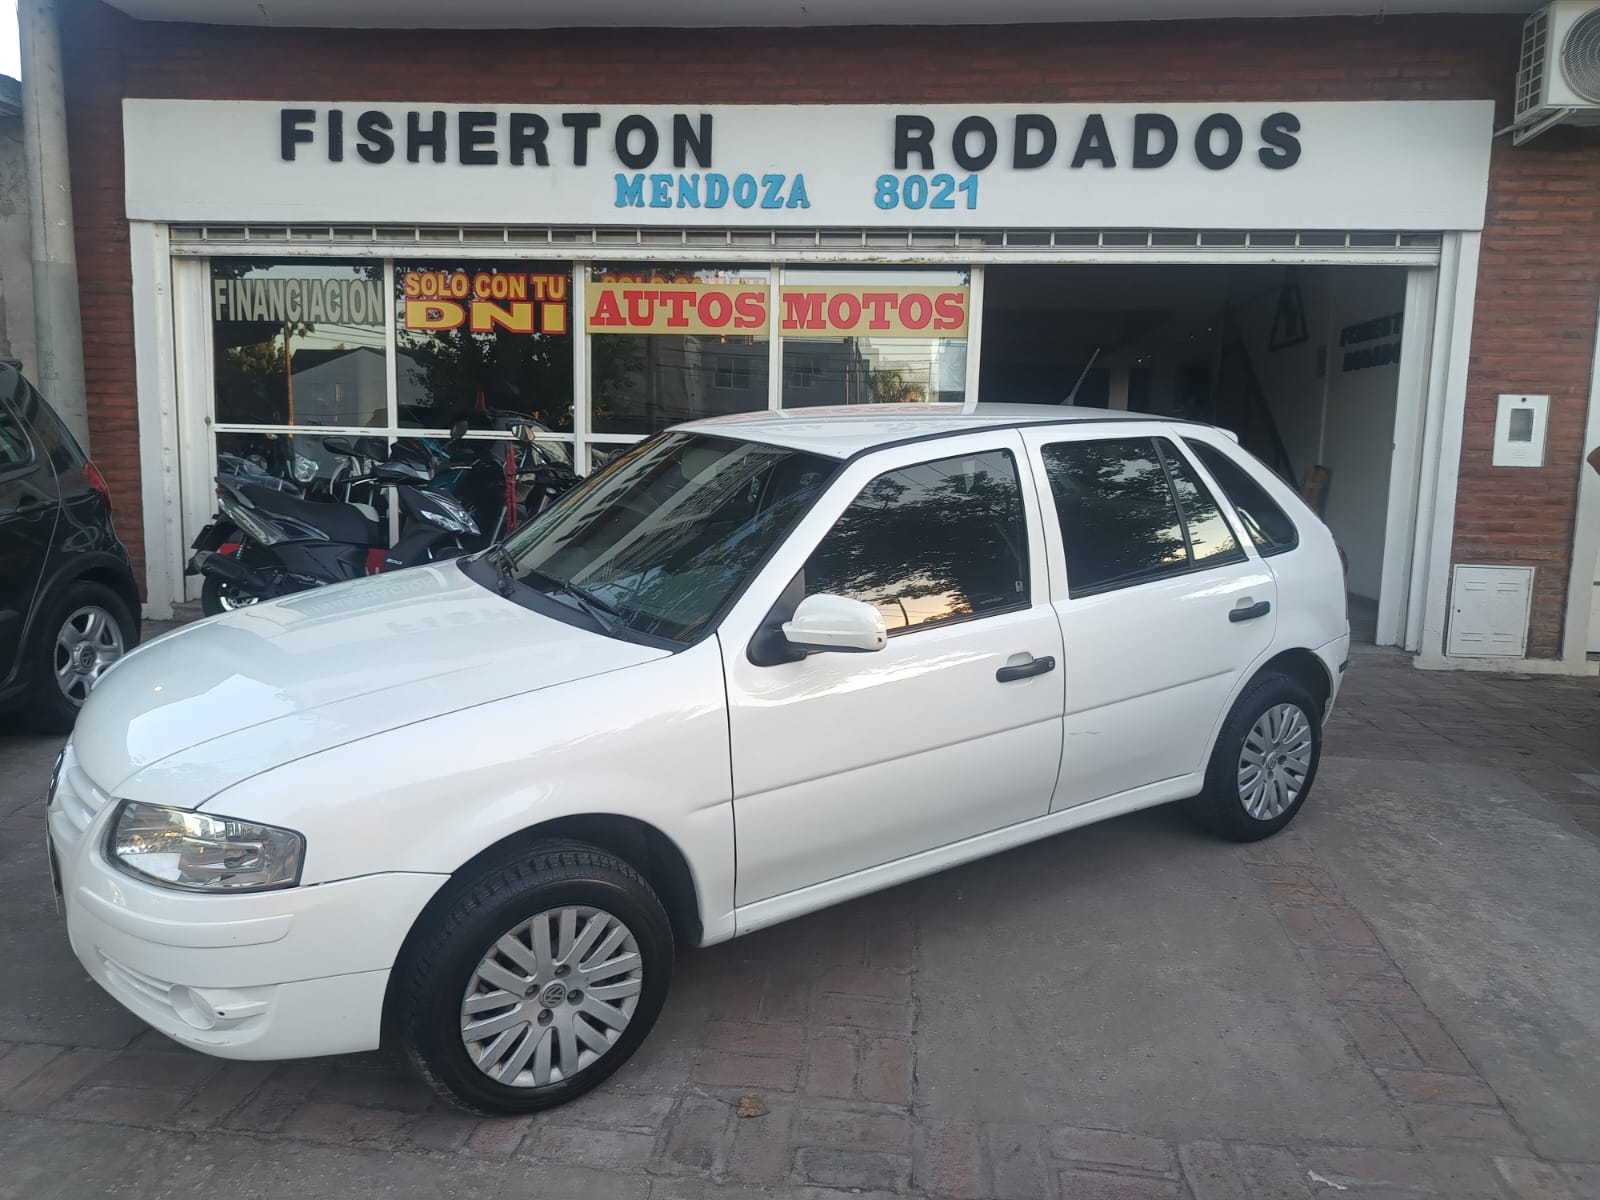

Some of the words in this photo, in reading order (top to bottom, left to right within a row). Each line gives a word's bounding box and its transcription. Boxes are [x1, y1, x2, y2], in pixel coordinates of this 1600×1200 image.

[281, 109, 713, 169] FISHERTON
[894, 112, 1301, 171] RODADOS
[615, 173, 810, 209] MENDOZA
[874, 174, 979, 210] 8021
[213, 278, 385, 325] FINANCIACION
[404, 271, 469, 299] SOLO
[473, 272, 528, 300] CON
[529, 274, 567, 301] TU
[405, 300, 567, 334] DNI
[589, 290, 766, 329] AUTOS
[782, 293, 964, 330] MOTOS
